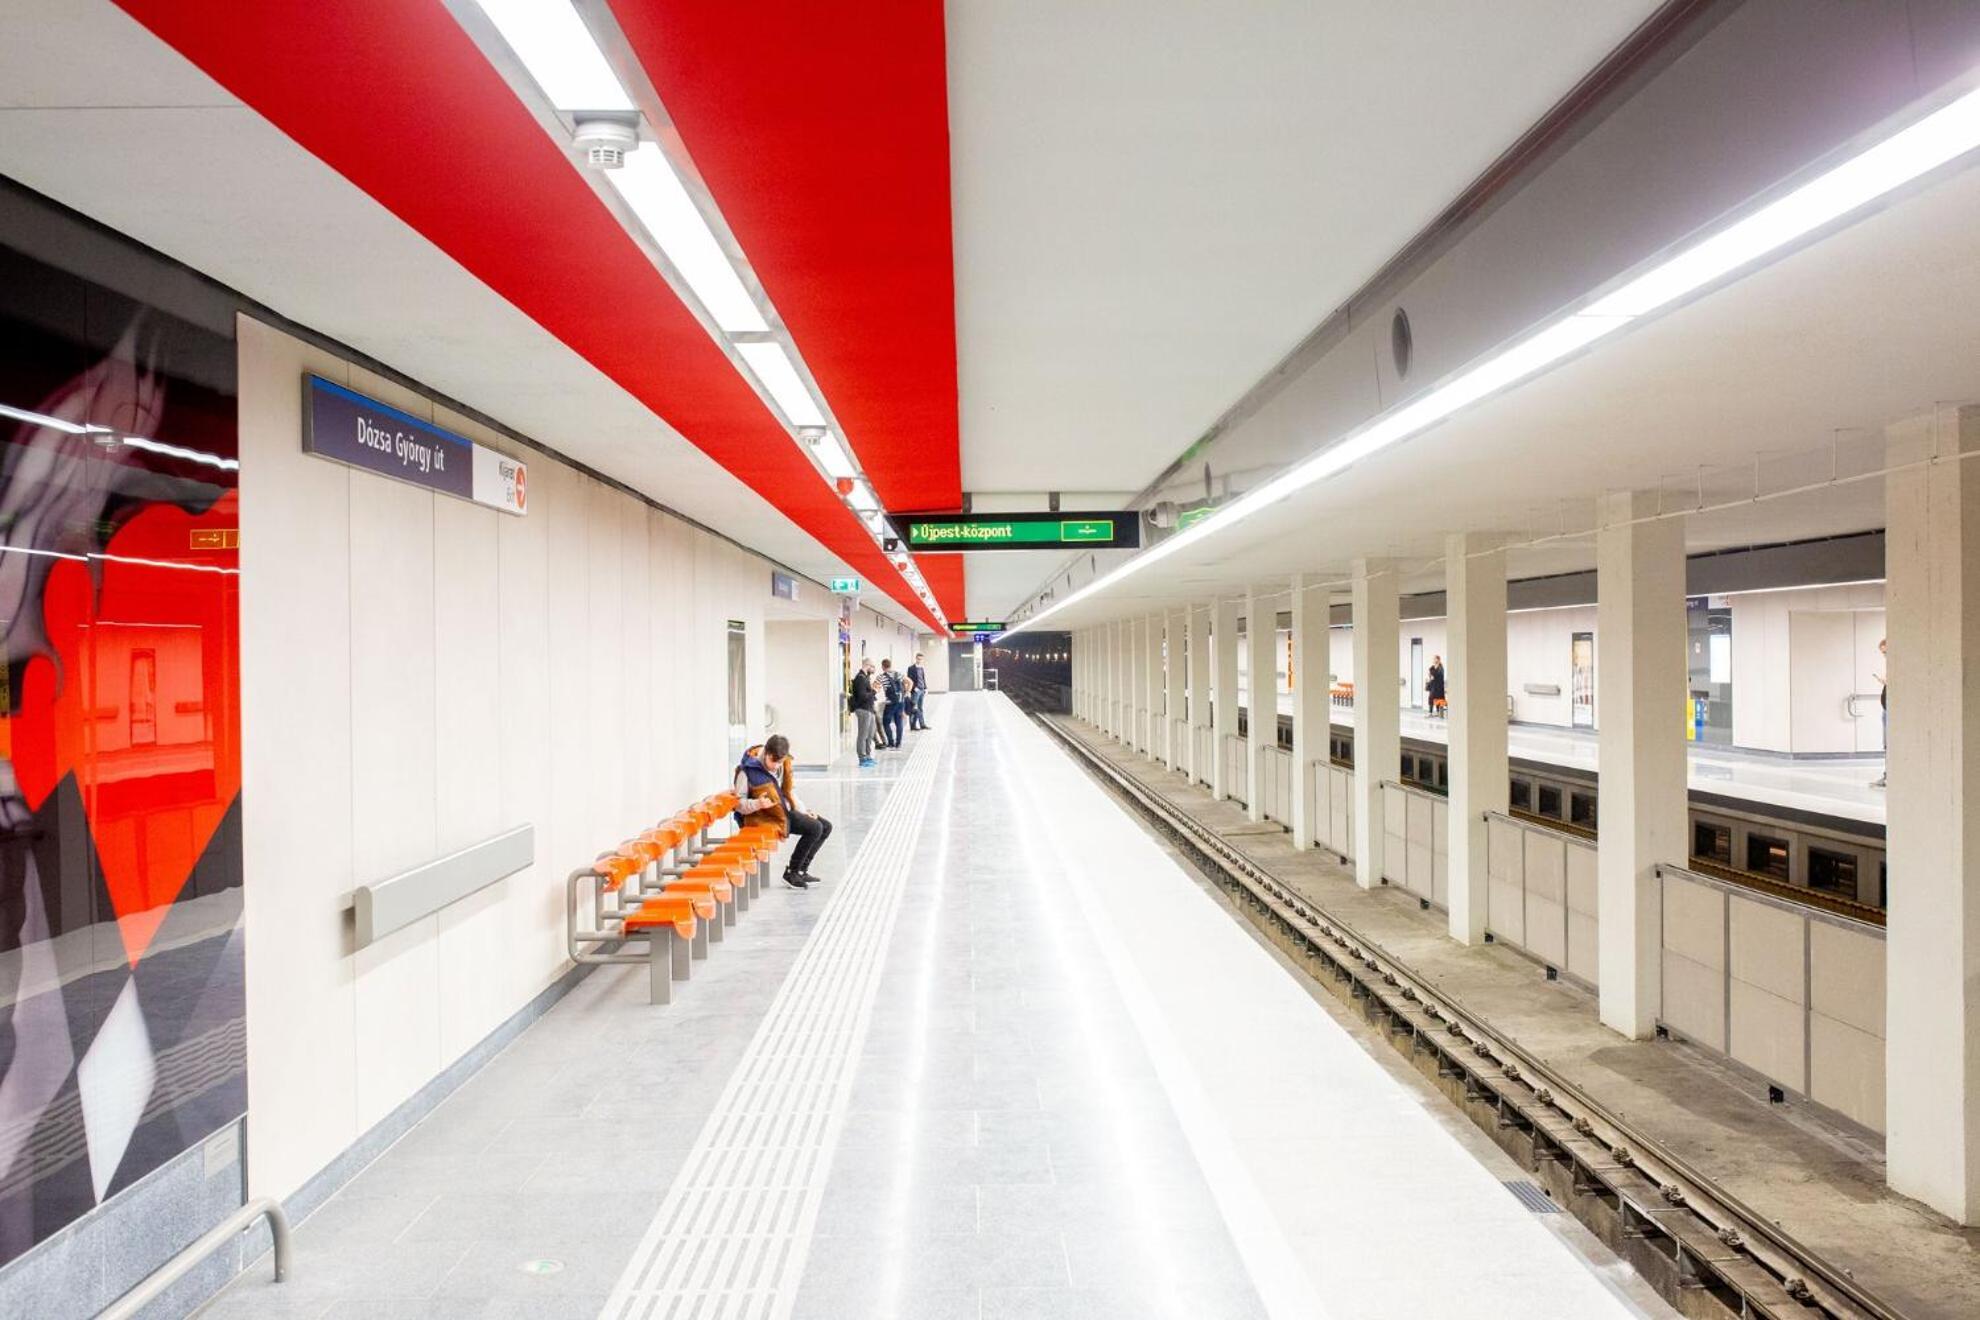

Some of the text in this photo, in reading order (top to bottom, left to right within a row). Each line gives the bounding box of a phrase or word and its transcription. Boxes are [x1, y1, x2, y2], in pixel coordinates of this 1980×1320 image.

[357, 416, 445, 473] Dózsa György út
[920, 524, 1013, 541] Újpest-központ
